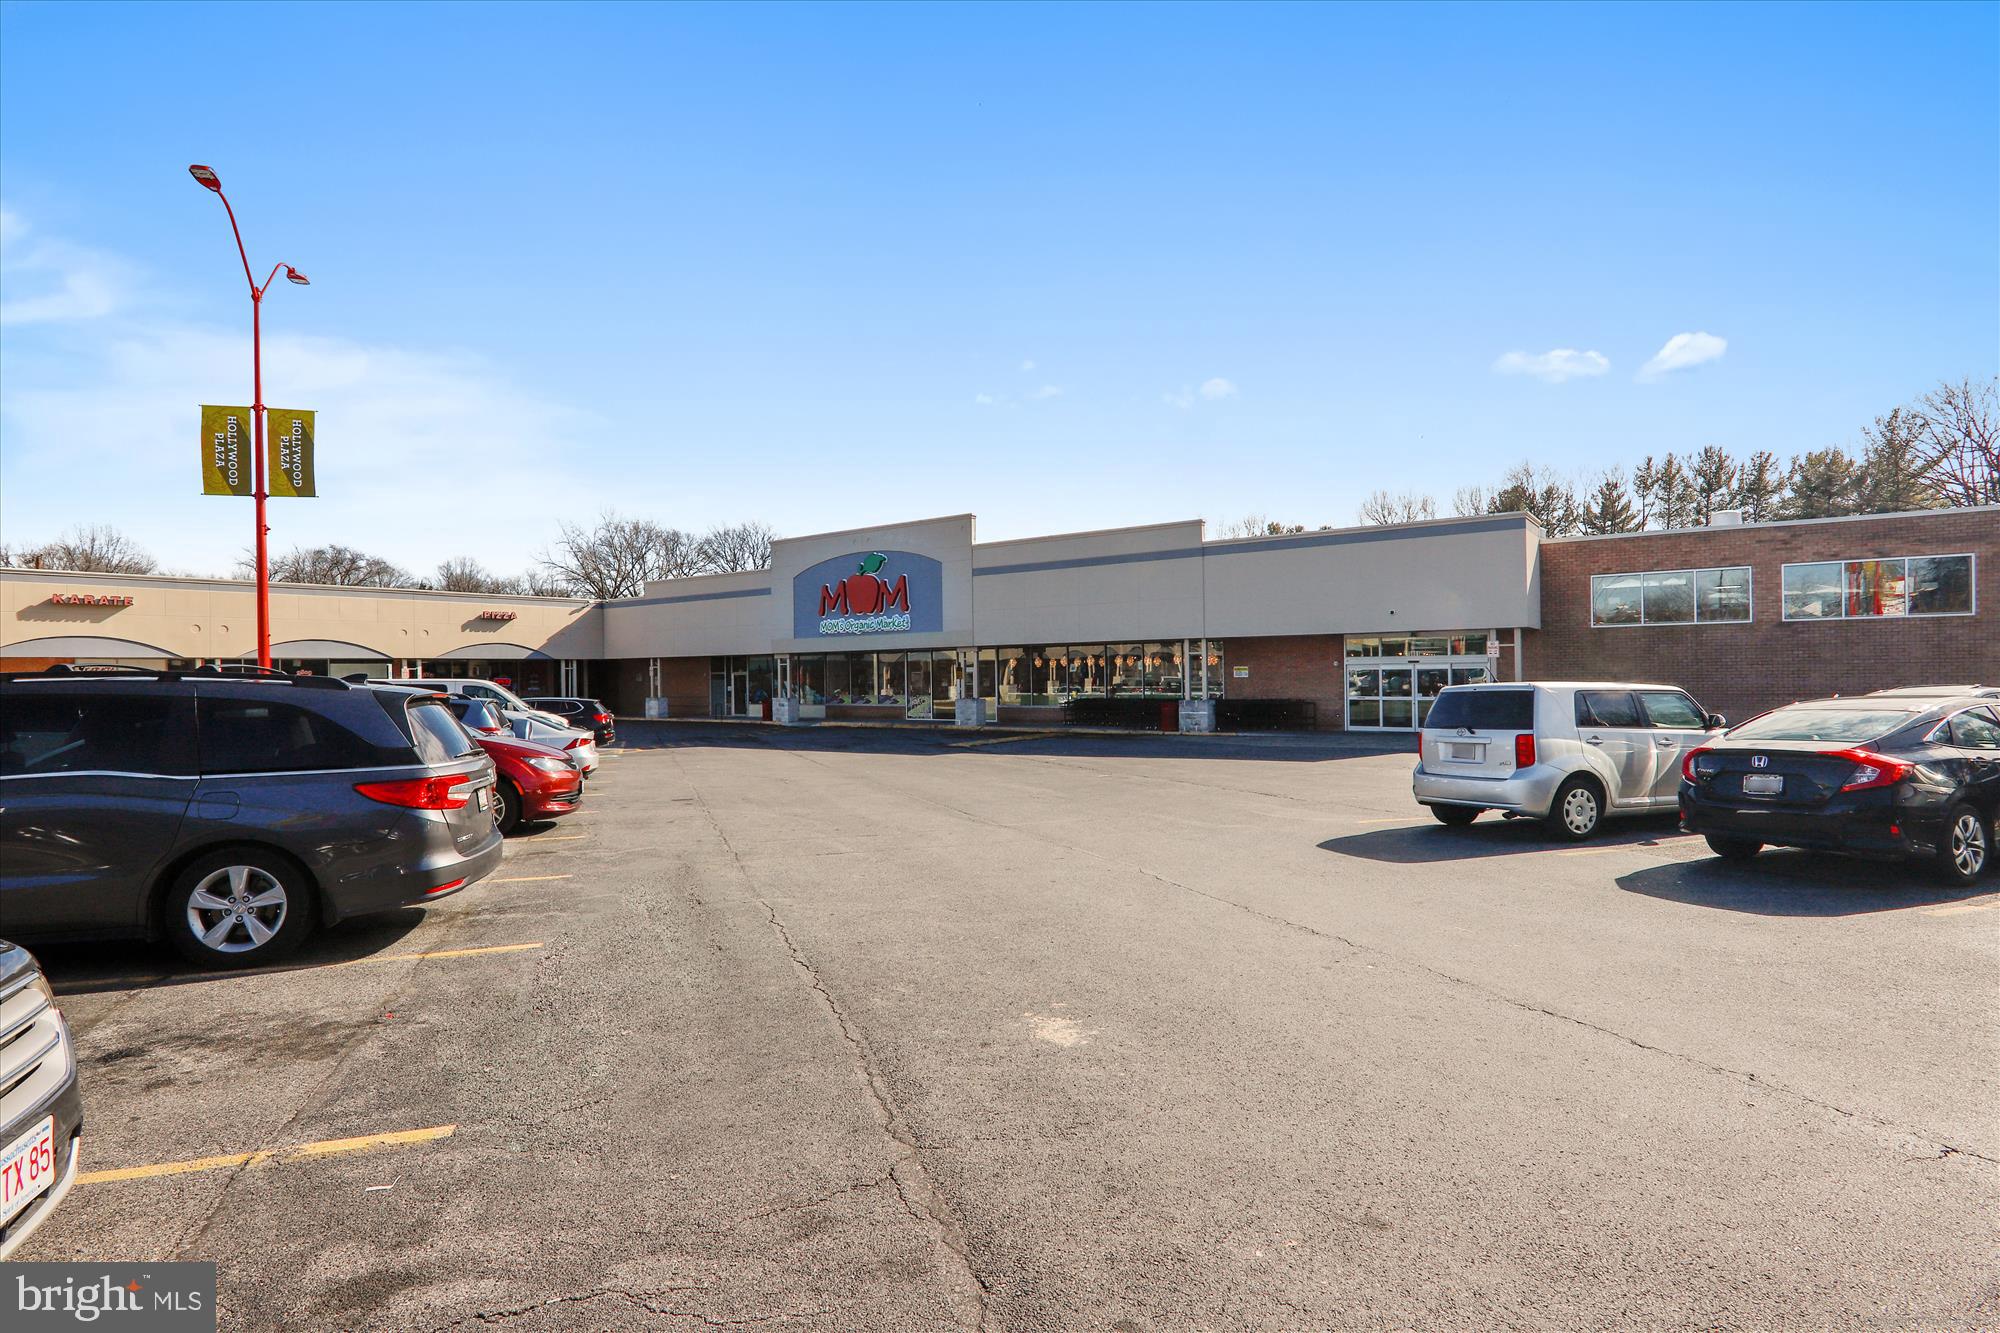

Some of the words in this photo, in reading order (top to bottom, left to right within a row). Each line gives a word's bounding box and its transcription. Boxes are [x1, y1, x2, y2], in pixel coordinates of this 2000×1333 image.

[215, 432, 225, 467] PLAZA
[227, 416, 238, 486] HOLLYWOOD
[280, 435, 290, 469] PLAZA
[292, 419, 302, 487] HOLLYWOOD
[51, 593, 134, 606] KARATE
[482, 610, 518, 619] PIZZA
[844, 617, 875, 634] Organic
[30, 1136, 50, 1181] 85
